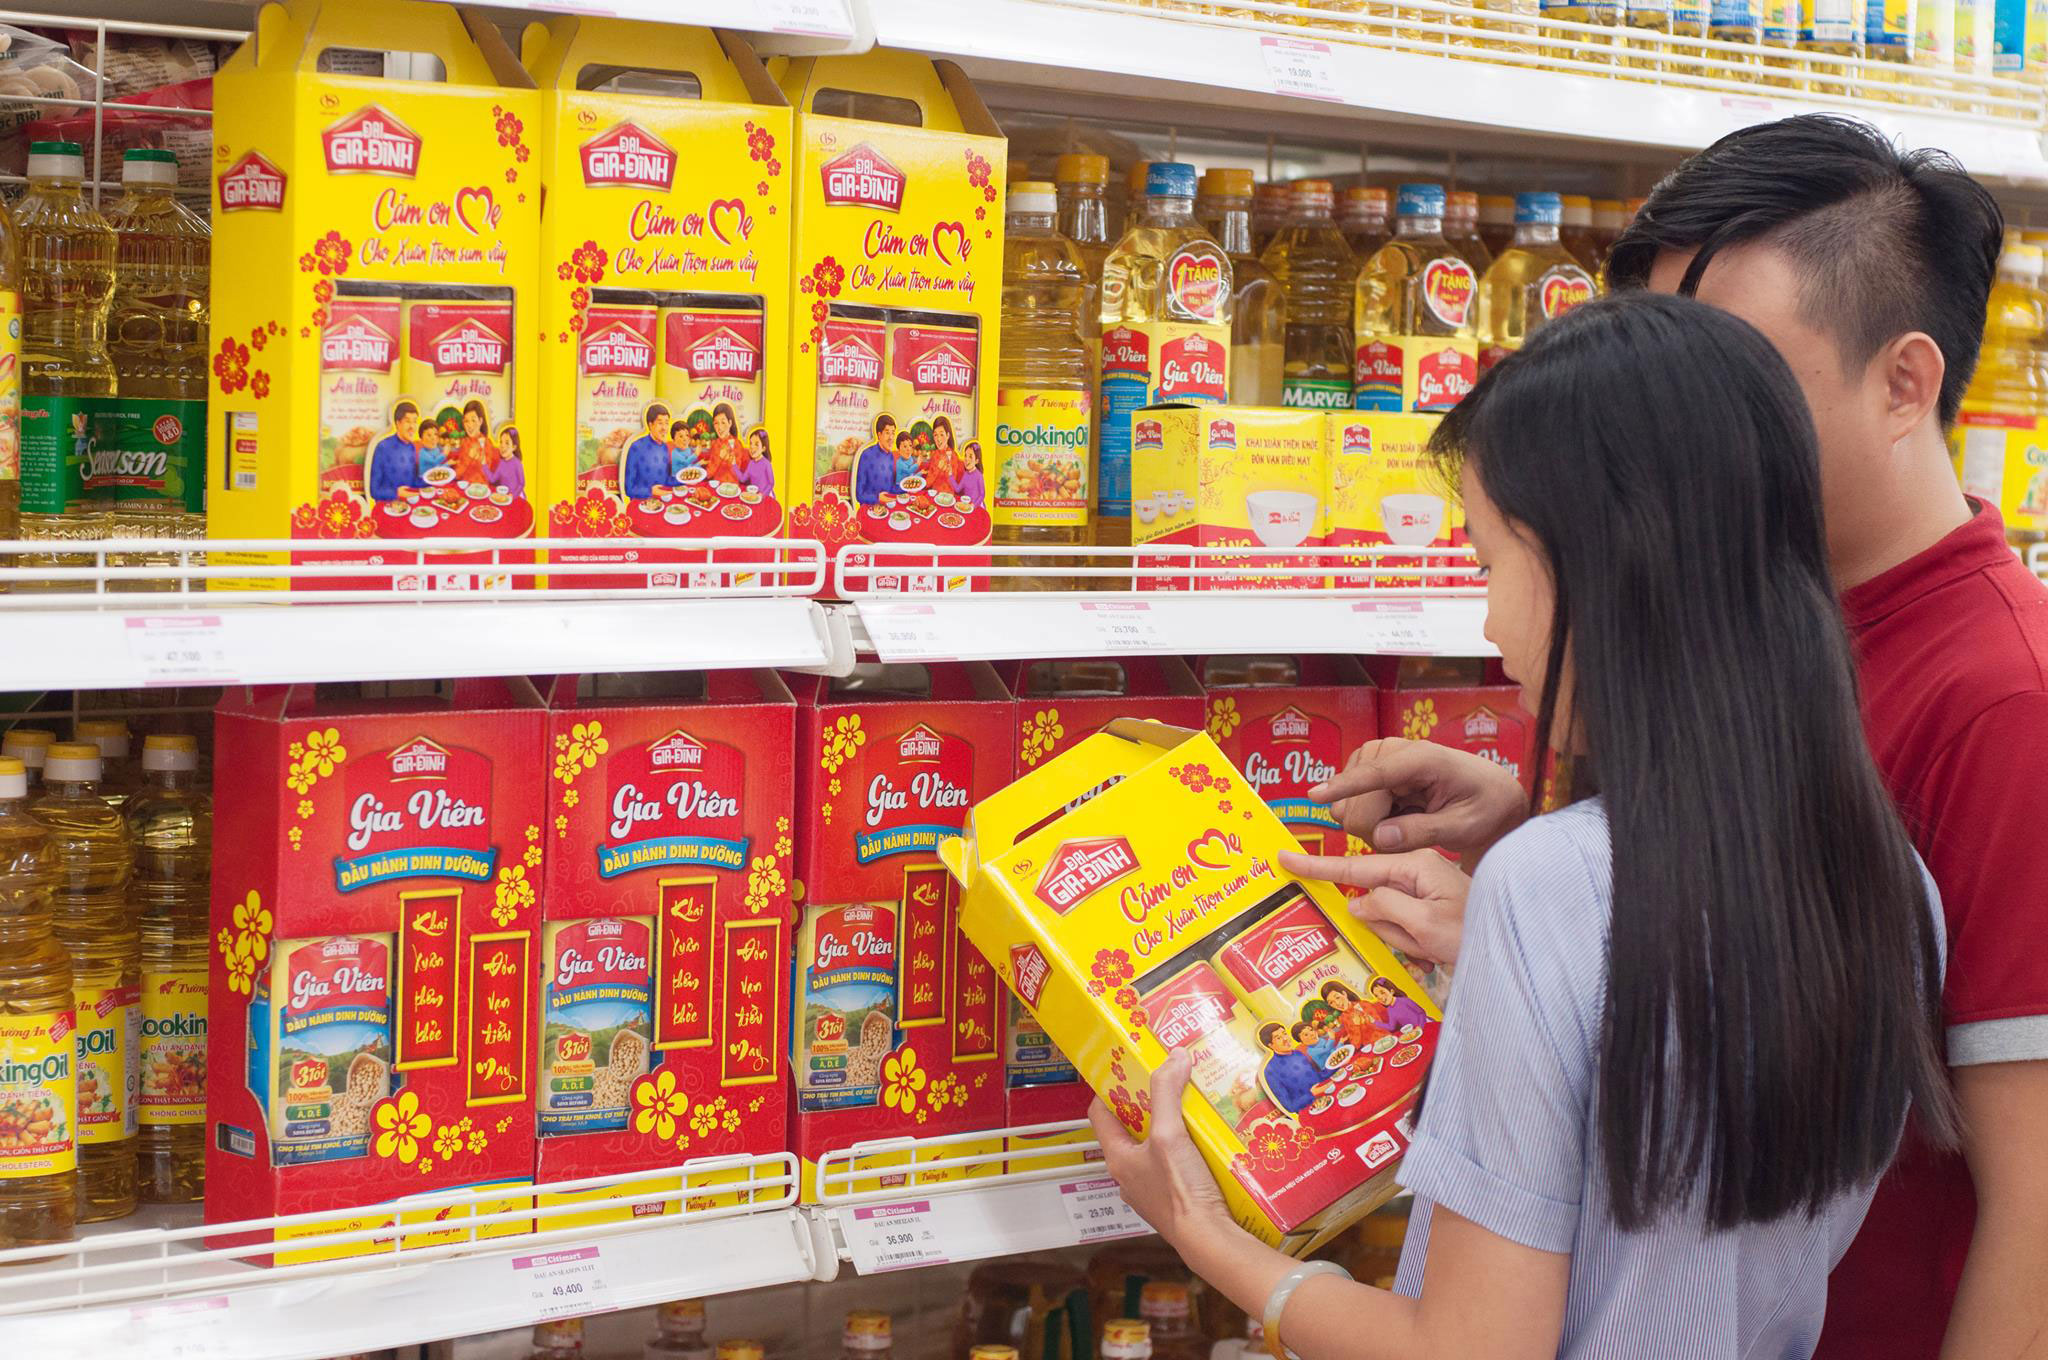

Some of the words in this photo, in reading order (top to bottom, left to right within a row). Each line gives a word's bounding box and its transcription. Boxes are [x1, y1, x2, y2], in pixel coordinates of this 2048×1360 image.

[629, 200, 679, 242] Cảm
[681, 214, 705, 237] ơn
[360, 238, 389, 267] Cho
[394, 237, 427, 266] Xuân
[459, 248, 483, 261] sum
[864, 220, 906, 260] Cảm
[908, 234, 929, 257] ơn
[614, 247, 644, 275] Cho
[646, 246, 679, 276] Xuân
[710, 257, 735, 272] sum
[851, 264, 876, 290] Cho
[878, 264, 906, 291] Xuân
[932, 276, 955, 291] sum
[1186, 266, 1219, 285] TẶNG
[1119, 346, 1147, 363] Viên
[1162, 361, 1189, 391] Gia
[1191, 360, 1224, 384] Viên
[1357, 359, 1372, 380] Gia
[1374, 359, 1402, 376] Viên
[1420, 374, 1443, 402] Gia
[996, 424, 1089, 449] CookingOi
[1246, 438, 1262, 449] KHAI
[1246, 752, 1282, 792] Gia
[1284, 750, 1336, 784] Viên
[610, 784, 663, 839] Gia
[666, 781, 739, 820] Viên
[866, 774, 908, 827] Gia
[911, 772, 969, 809] Viên
[1288, 805, 1309, 819] DINH
[348, 793, 404, 851] Gia
[408, 789, 486, 830] Viên
[604, 850, 630, 873] DẦU
[632, 847, 667, 864] NÀNH
[669, 844, 699, 859] DINH
[701, 844, 743, 866] DƯỠNG
[861, 836, 881, 858] DẦU
[884, 834, 911, 849] NÀNH
[912, 832, 936, 846] DINH
[341, 861, 369, 886] DẦU
[372, 857, 408, 877] NÀNH
[411, 856, 442, 871] DINH
[444, 855, 489, 878] DƯỠNG
[912, 884, 940, 906] Khai
[1120, 880, 1171, 924] Cảm
[1172, 862, 1199, 890] ơn
[1132, 928, 1163, 957] Cho
[1164, 906, 1198, 941] Xuân
[1224, 875, 1249, 899] sum
[1248, 856, 1277, 882] vầy
[670, 897, 705, 922] Khai
[412, 910, 448, 937] Khai
[817, 933, 850, 969] Gia
[852, 932, 893, 956] Viên
[558, 949, 595, 986] Gia
[598, 946, 646, 972] Viên
[291, 970, 331, 1009] Gia
[333, 967, 385, 993] Viên
[812, 974, 829, 991] DẦU
[853, 971, 871, 983] DINH
[552, 991, 573, 1008] DẦU
[600, 988, 621, 1000] DINH
[140, 1013, 208, 1038] ookin
[886, 1206, 916, 1216] Citimart
[886, 1233, 914, 1246] 36,900
[552, 1282, 583, 1297] 49,400
